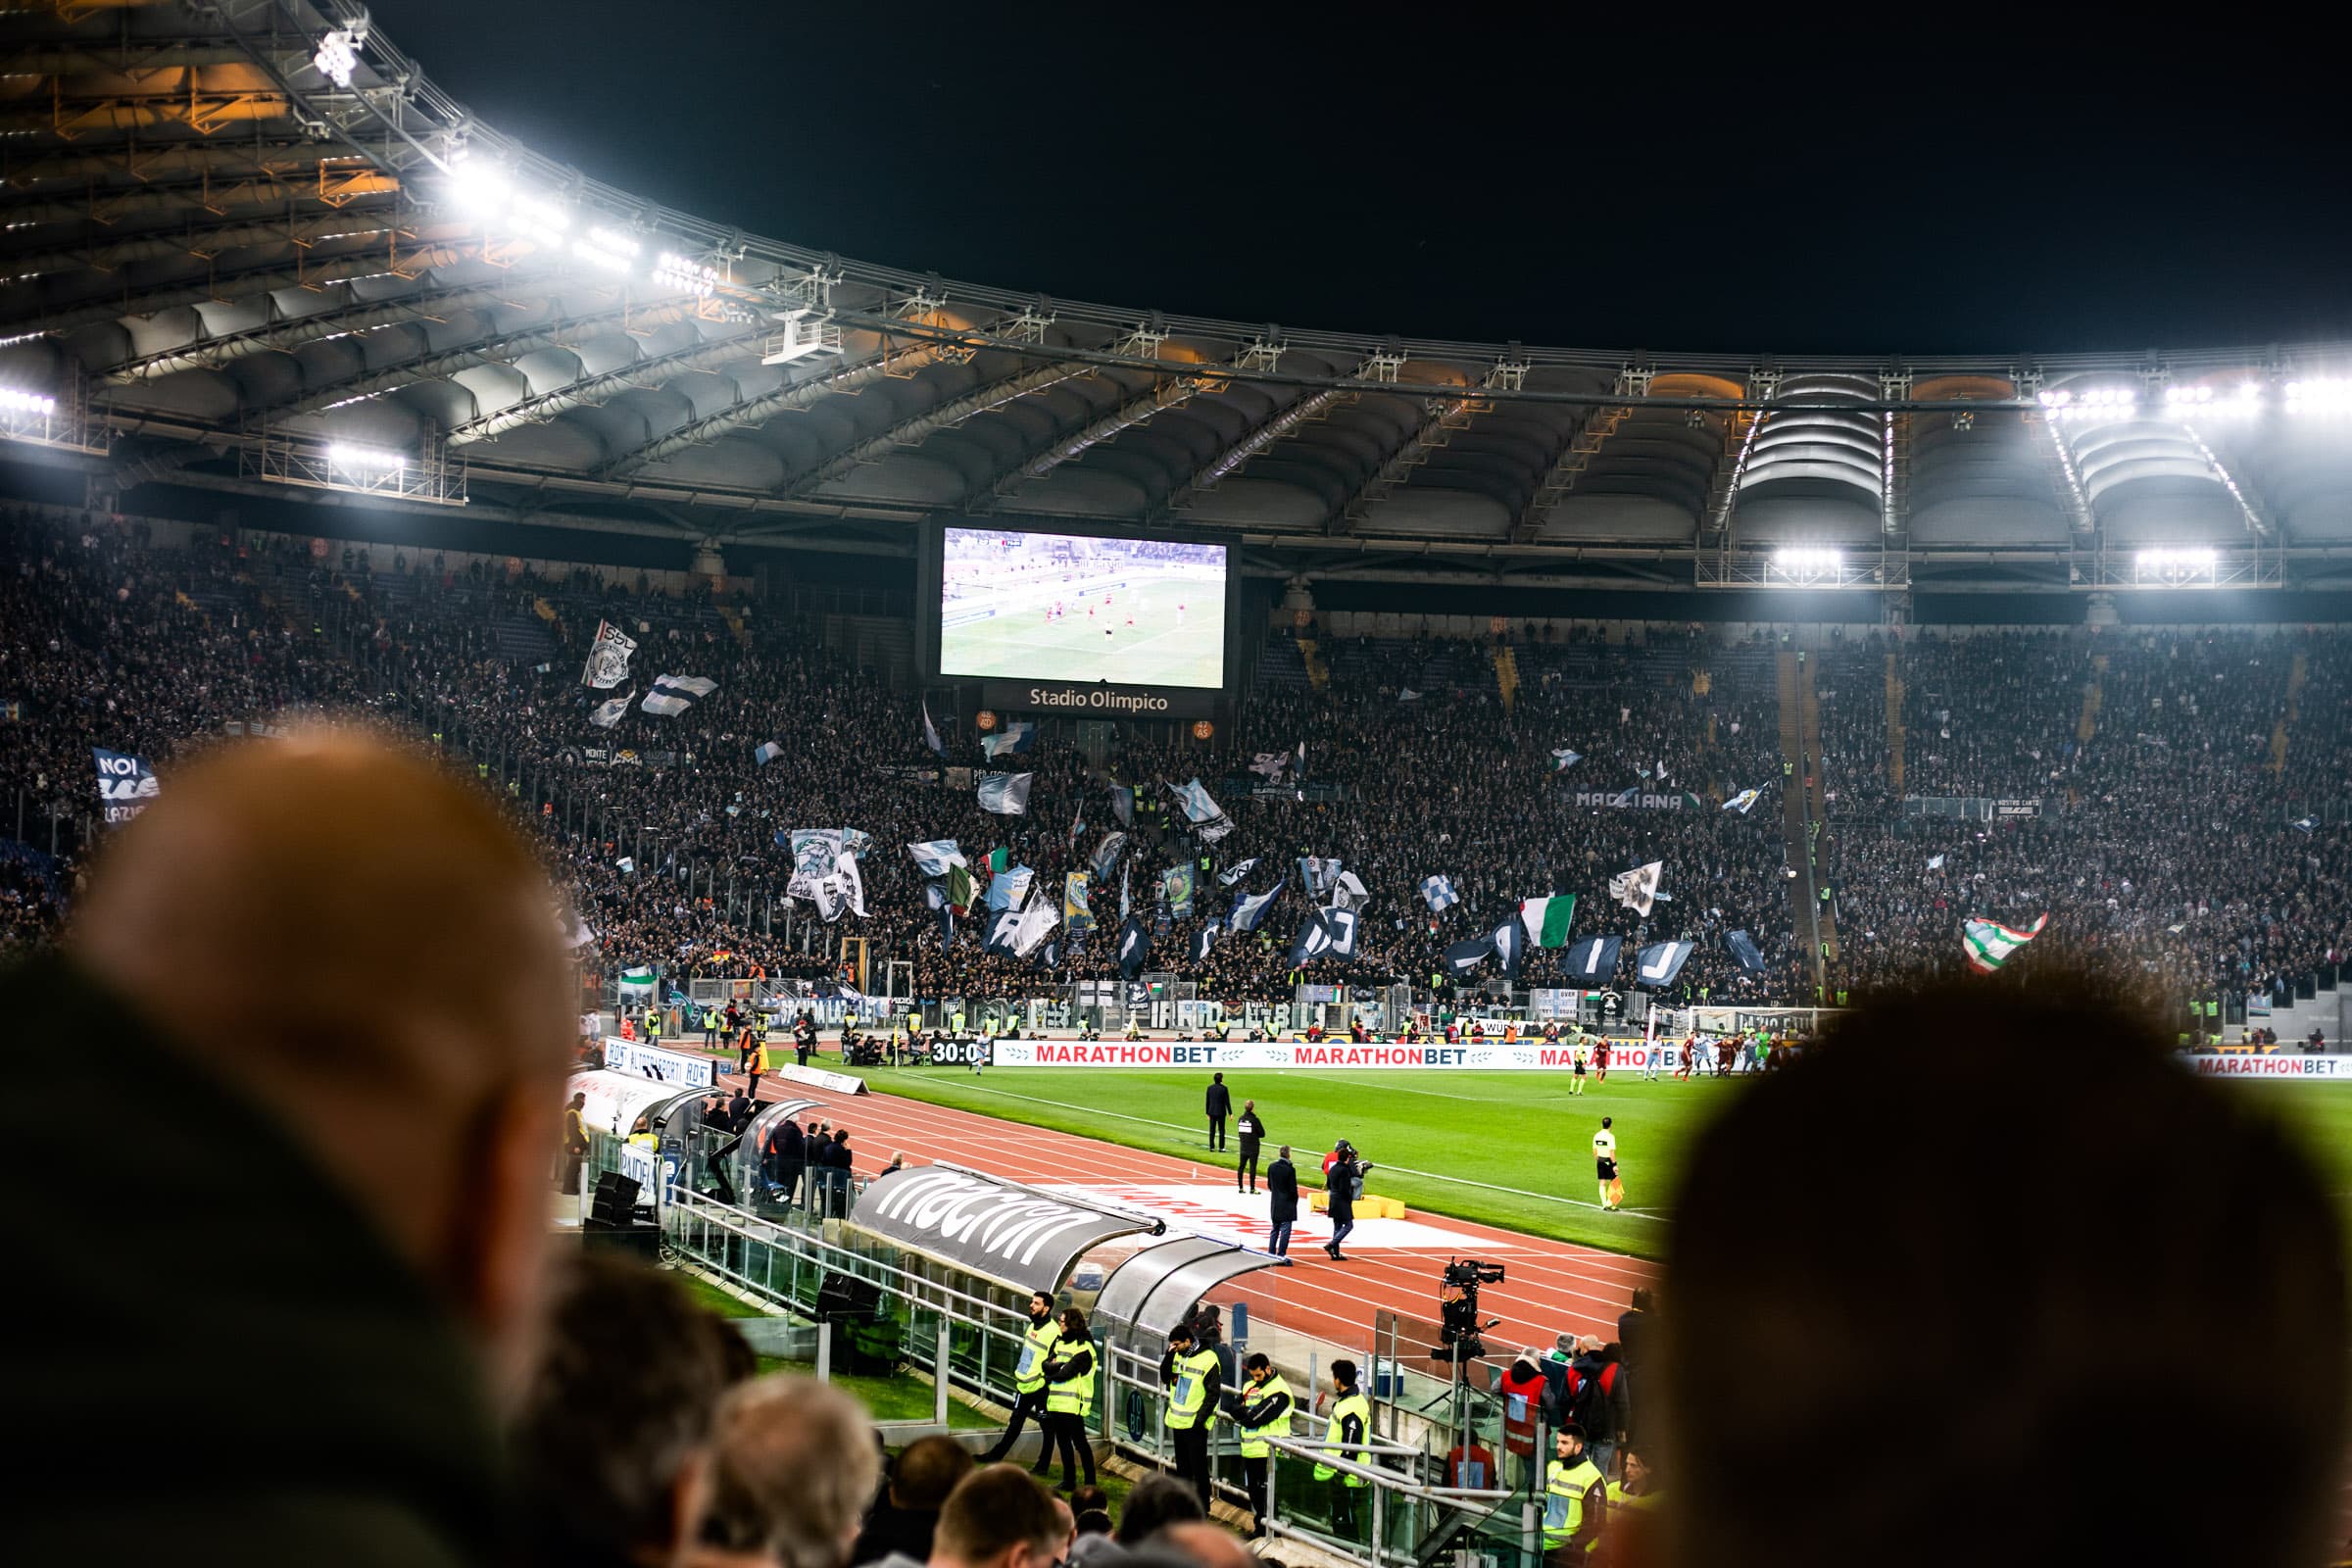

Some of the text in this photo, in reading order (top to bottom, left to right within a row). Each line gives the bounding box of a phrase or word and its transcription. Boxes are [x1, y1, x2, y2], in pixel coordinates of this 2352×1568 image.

[1030, 688, 1168, 712] Stadio Olimpico
[99, 758, 137, 775] NOI
[1576, 792, 1683, 809] MAGIANA
[828, 999, 872, 1024] LAZLE
[1486, 1020, 1522, 1034] WÜH
[933, 1042, 991, 1063] 30:0
[1037, 1045, 1217, 1063] MARATHONBET
[1295, 1048, 1467, 1065] MARATHONBET
[2199, 1058, 2337, 1074] MARATHONBET
[876, 1172, 1103, 1266] macron
